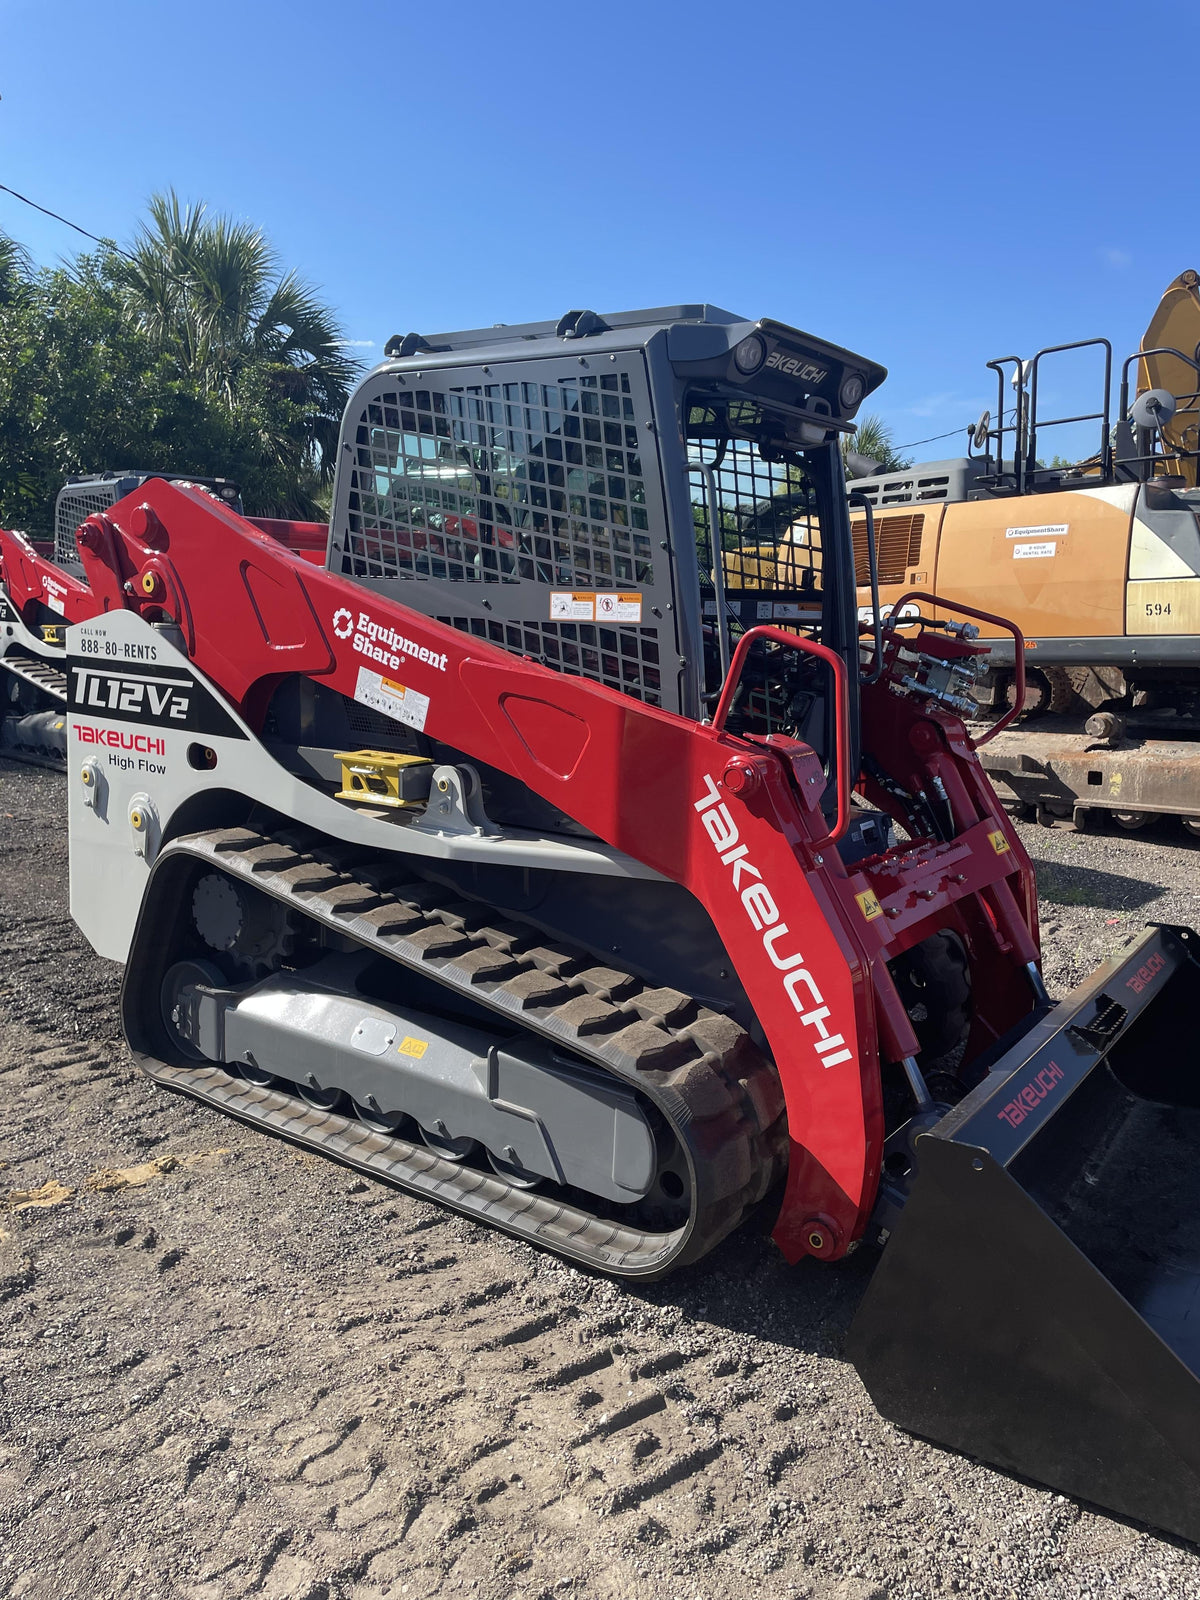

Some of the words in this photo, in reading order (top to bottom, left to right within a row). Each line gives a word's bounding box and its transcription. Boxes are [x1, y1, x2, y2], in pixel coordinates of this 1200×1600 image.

[765, 351, 828, 384] AKEUCHI
[1145, 602, 1172, 616] 594
[80, 628, 93, 636] CALL
[356, 612, 448, 672] Equipment
[81, 638, 157, 660] 888-80-RENTS
[72, 666, 194, 720] TL12V2
[108, 754, 134, 770] High
[138, 758, 166, 775] Flow
